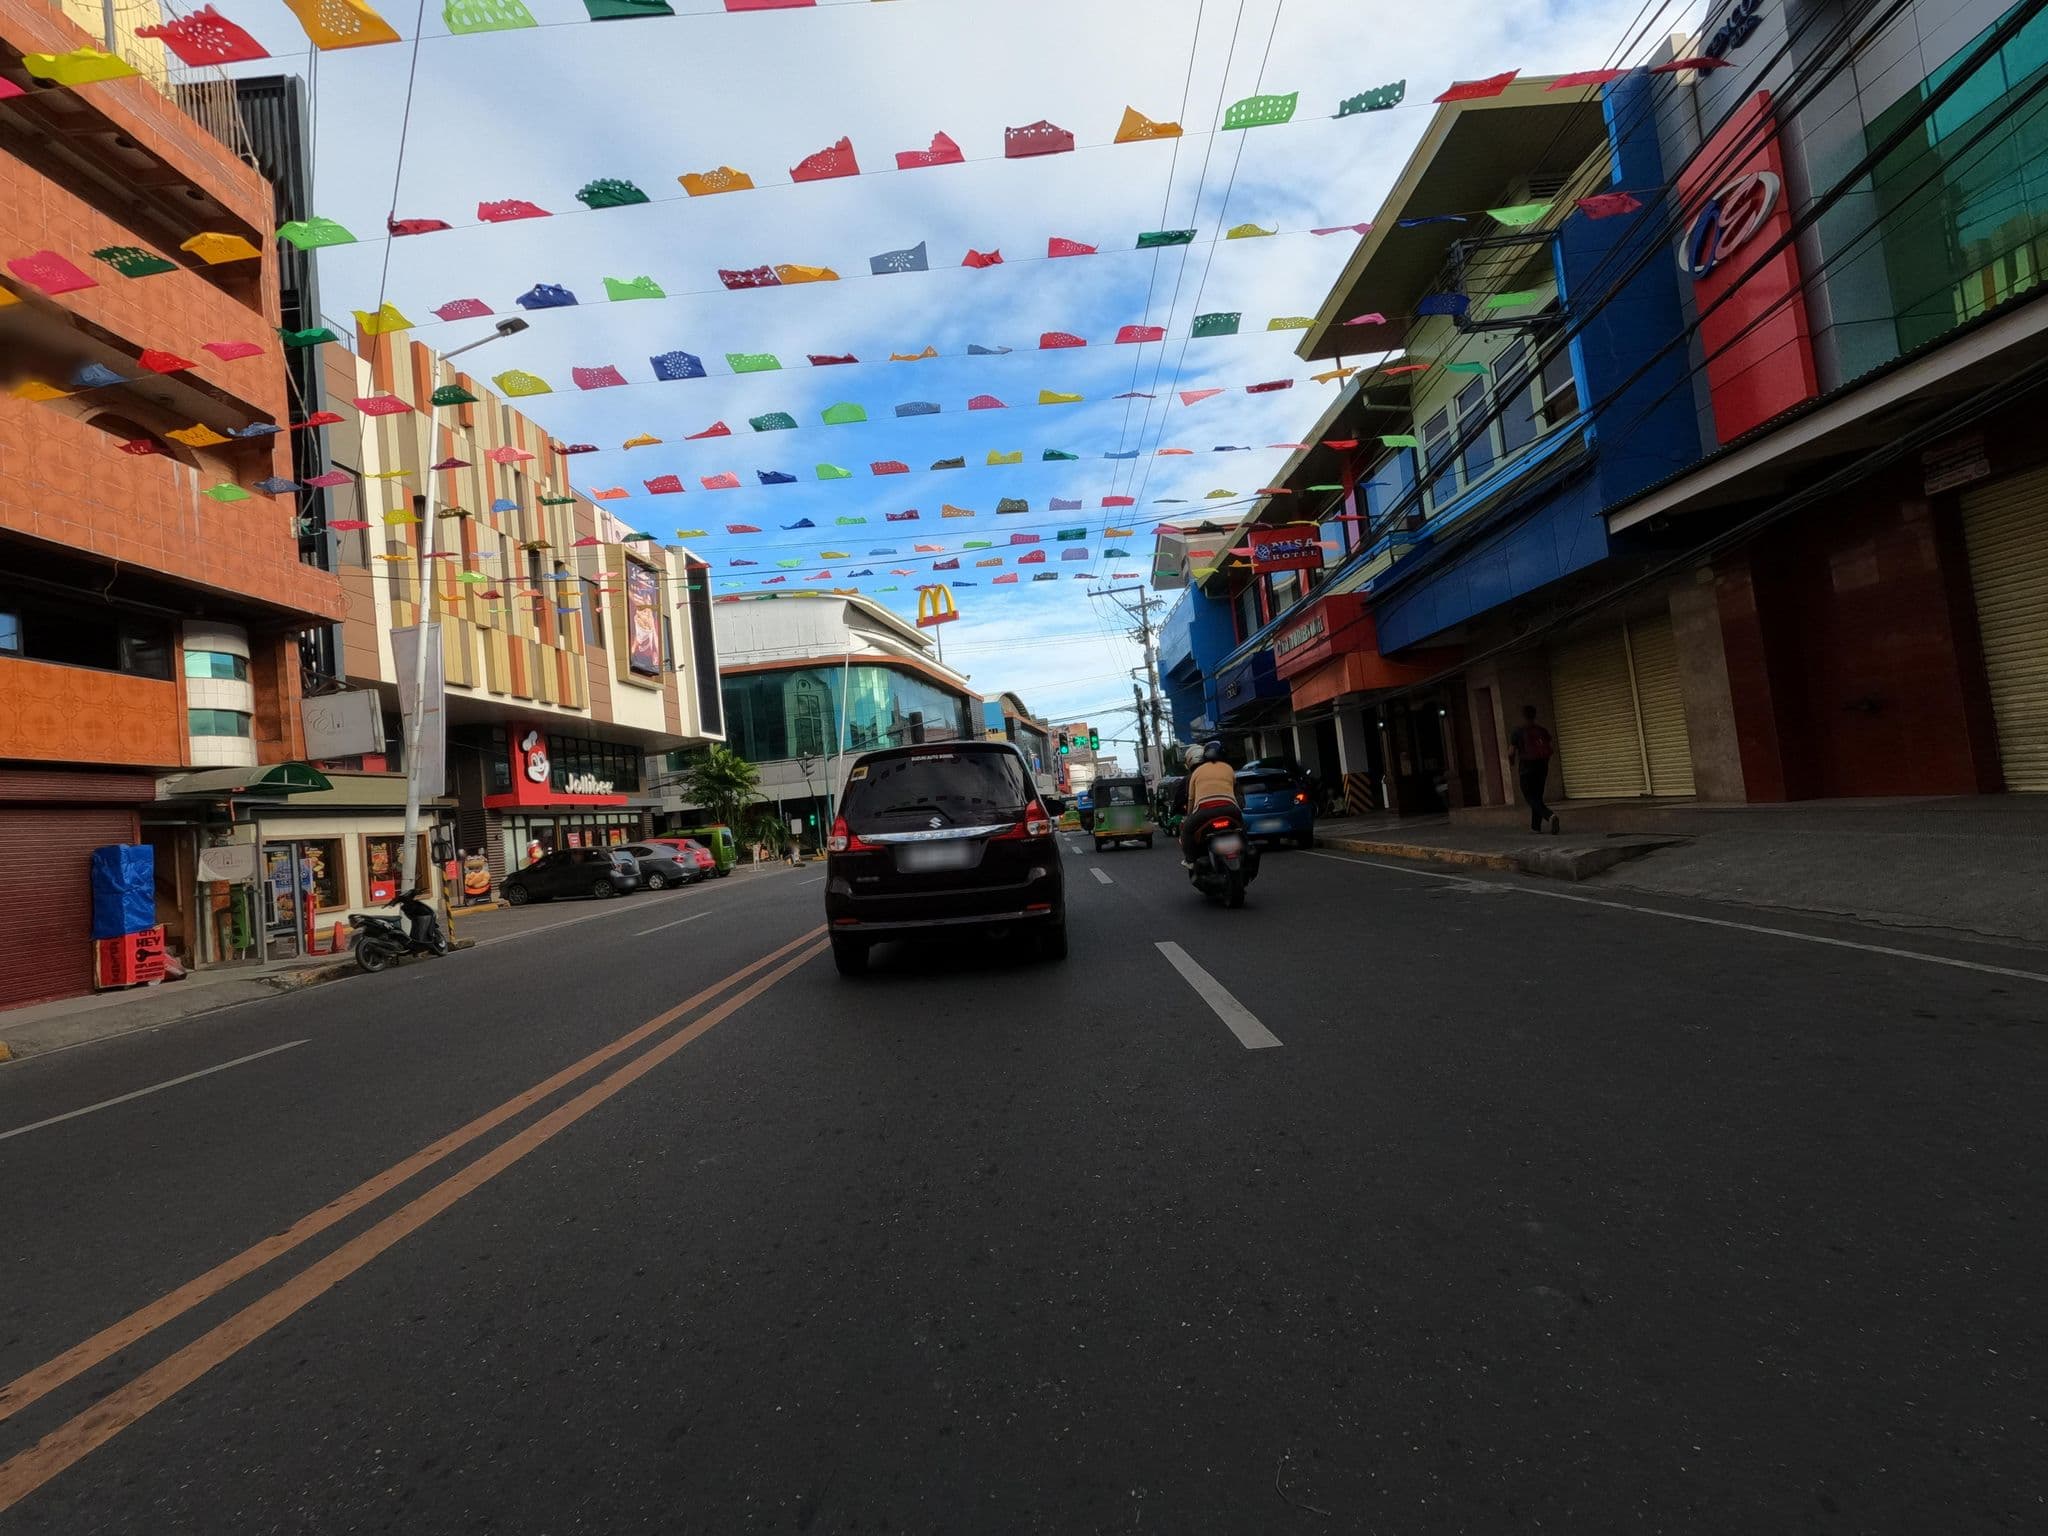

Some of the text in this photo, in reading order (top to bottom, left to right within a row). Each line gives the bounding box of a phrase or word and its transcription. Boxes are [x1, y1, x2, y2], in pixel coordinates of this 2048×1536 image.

[1271, 550, 1318, 561] HOTEL
[564, 771, 614, 796] Jollibee
[136, 936, 161, 948] KEY
